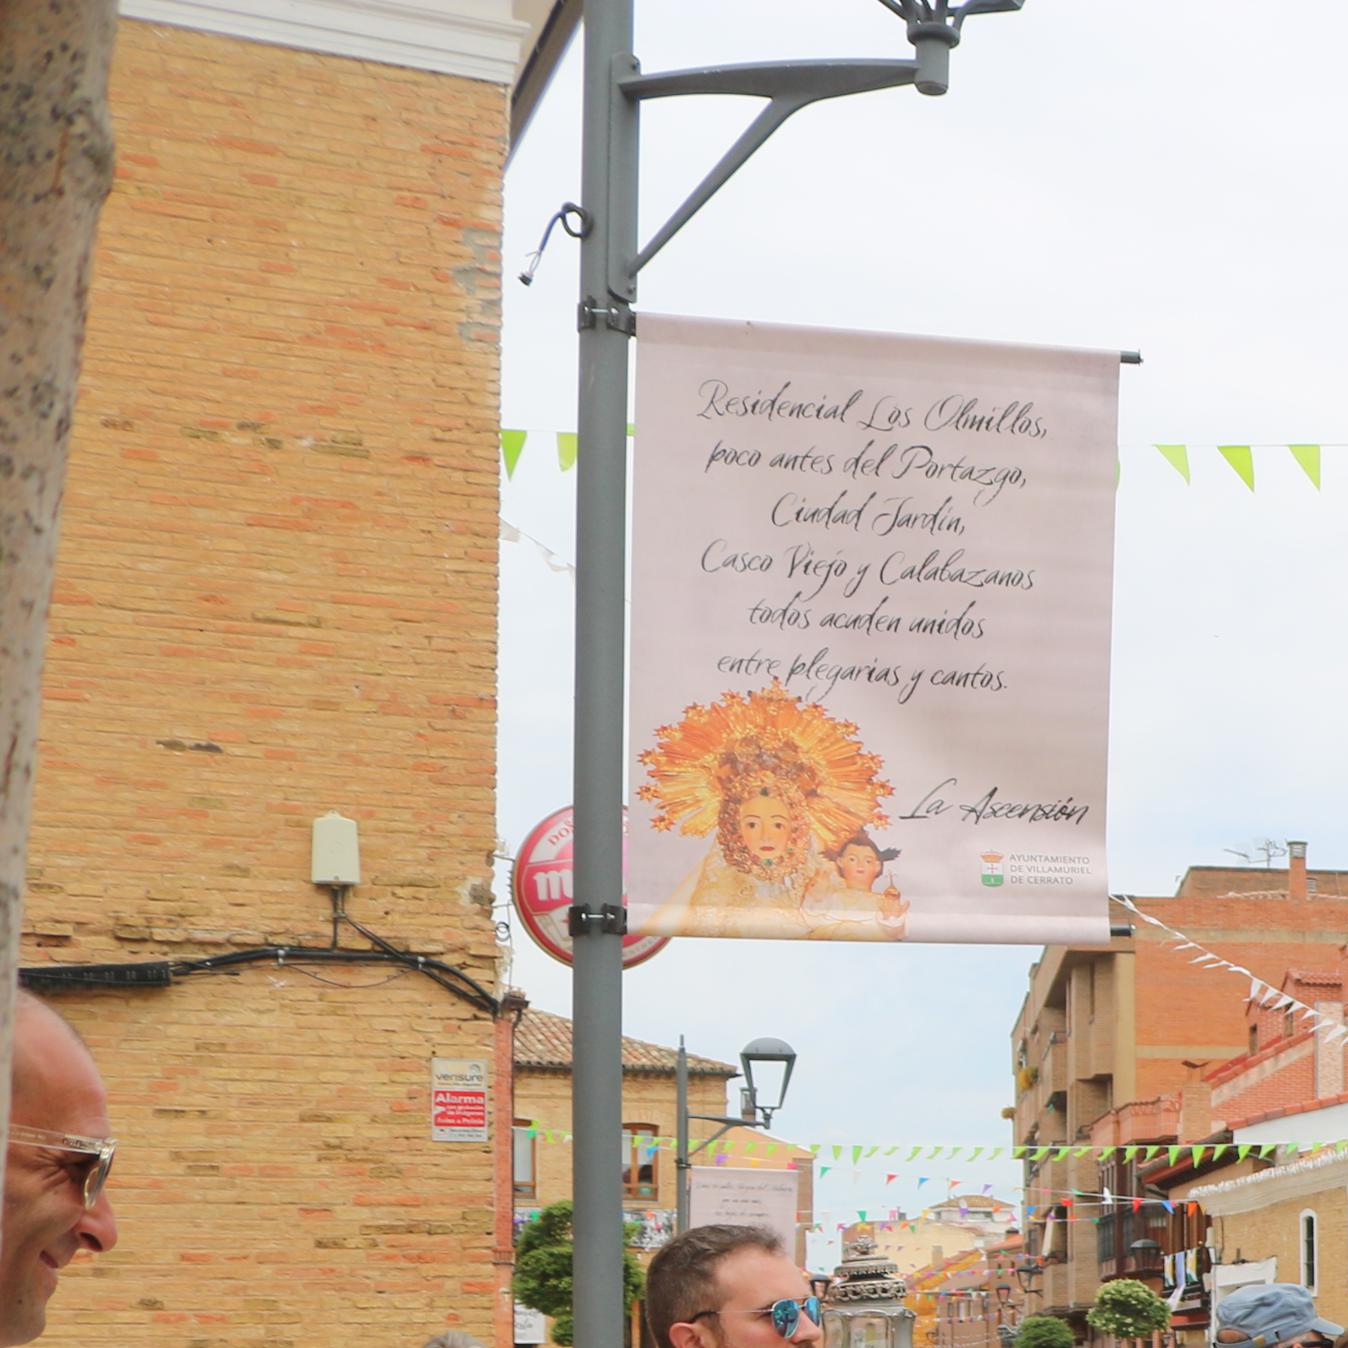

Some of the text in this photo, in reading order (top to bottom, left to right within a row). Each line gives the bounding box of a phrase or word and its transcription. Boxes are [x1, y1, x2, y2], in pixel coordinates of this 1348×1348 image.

[697, 379, 864, 424] Residencial
[857, 395, 911, 432] Los
[704, 439, 1027, 507] poco antes del Portazgo,
[771, 490, 877, 531] Ciudad
[700, 538, 1036, 602] Casco Viejo y Calabazanos
[748, 591, 985, 640] todos acuden unidos
[717, 647, 1008, 705] entre plegarias y cantos.
[899, 777, 1090, 825] La Ascensión
[1009, 854, 1090, 865] AYUNTAMIENTO
[1010, 864, 1092, 874] DE VILLAMURIEL
[1010, 875, 1073, 885] DE CERRATO
[435, 1093, 484, 1104] Alarma
